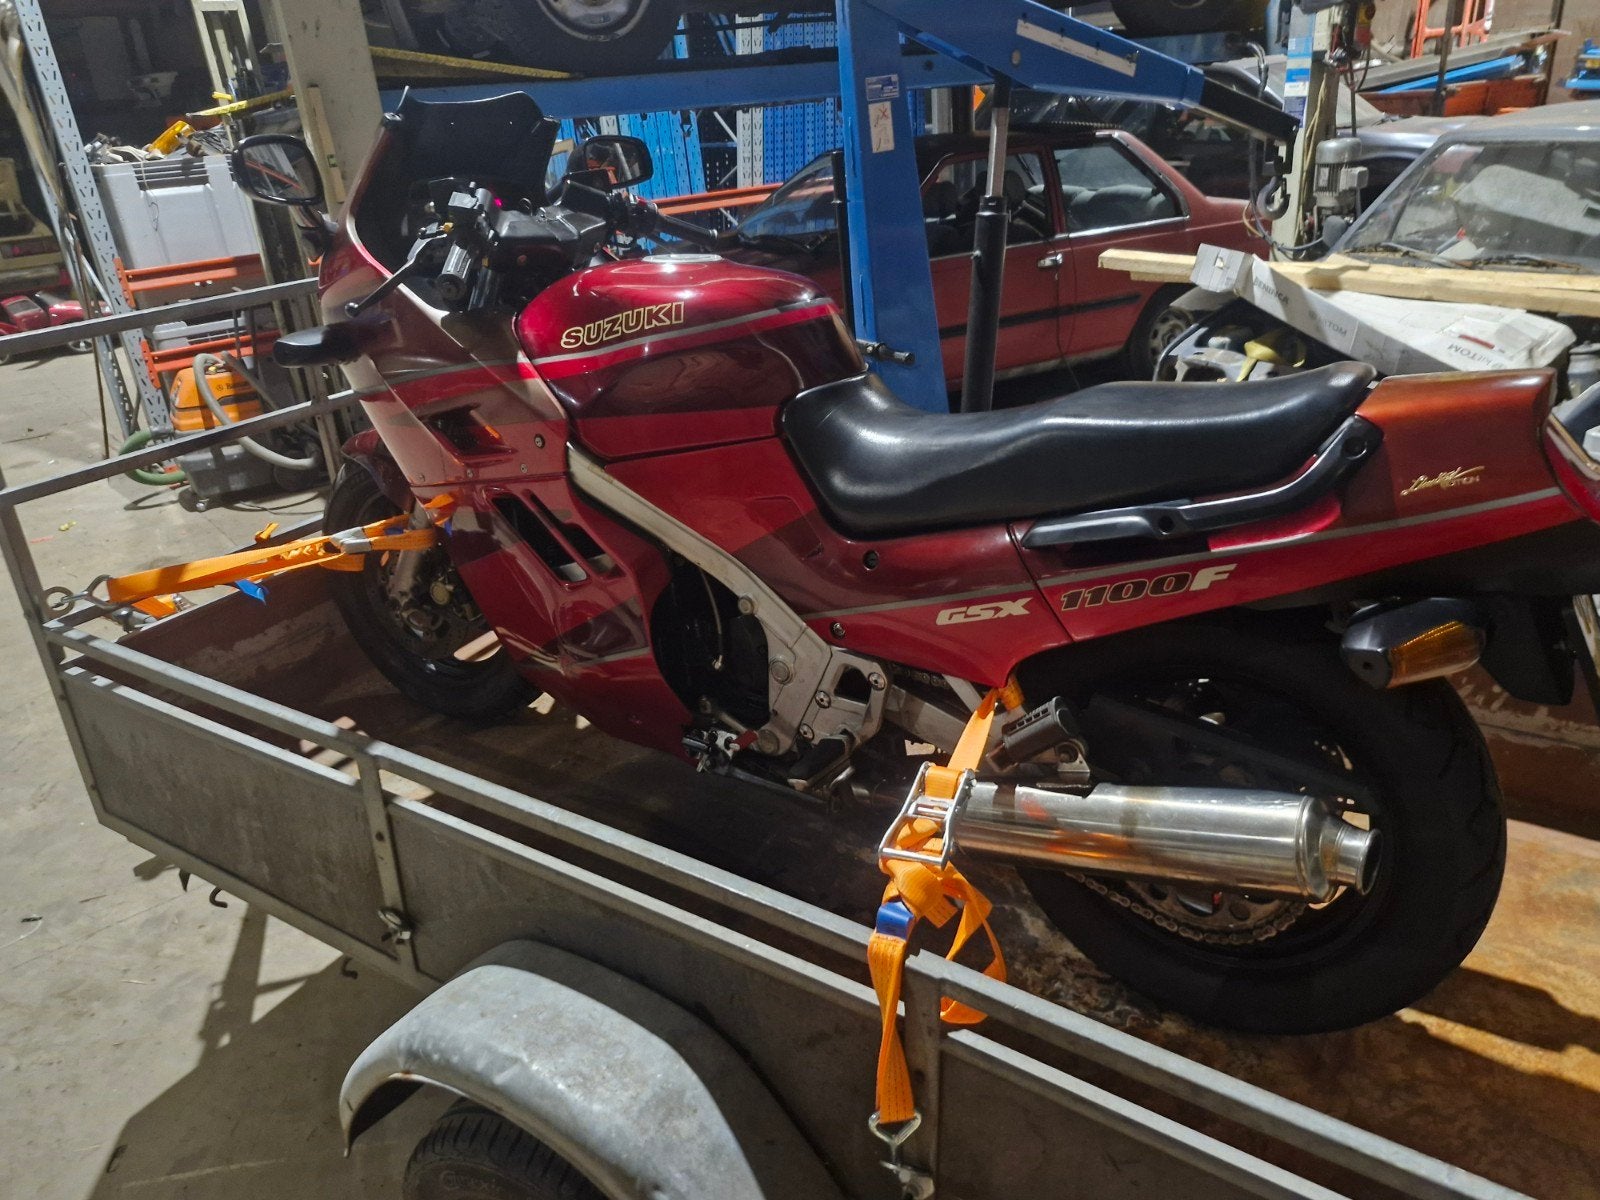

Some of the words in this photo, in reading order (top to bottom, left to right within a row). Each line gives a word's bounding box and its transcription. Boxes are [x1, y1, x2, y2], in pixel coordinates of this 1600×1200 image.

[561, 301, 684, 348] SUZUKI
[936, 597, 1033, 625] GSX
[1061, 563, 1237, 611] 1100F
